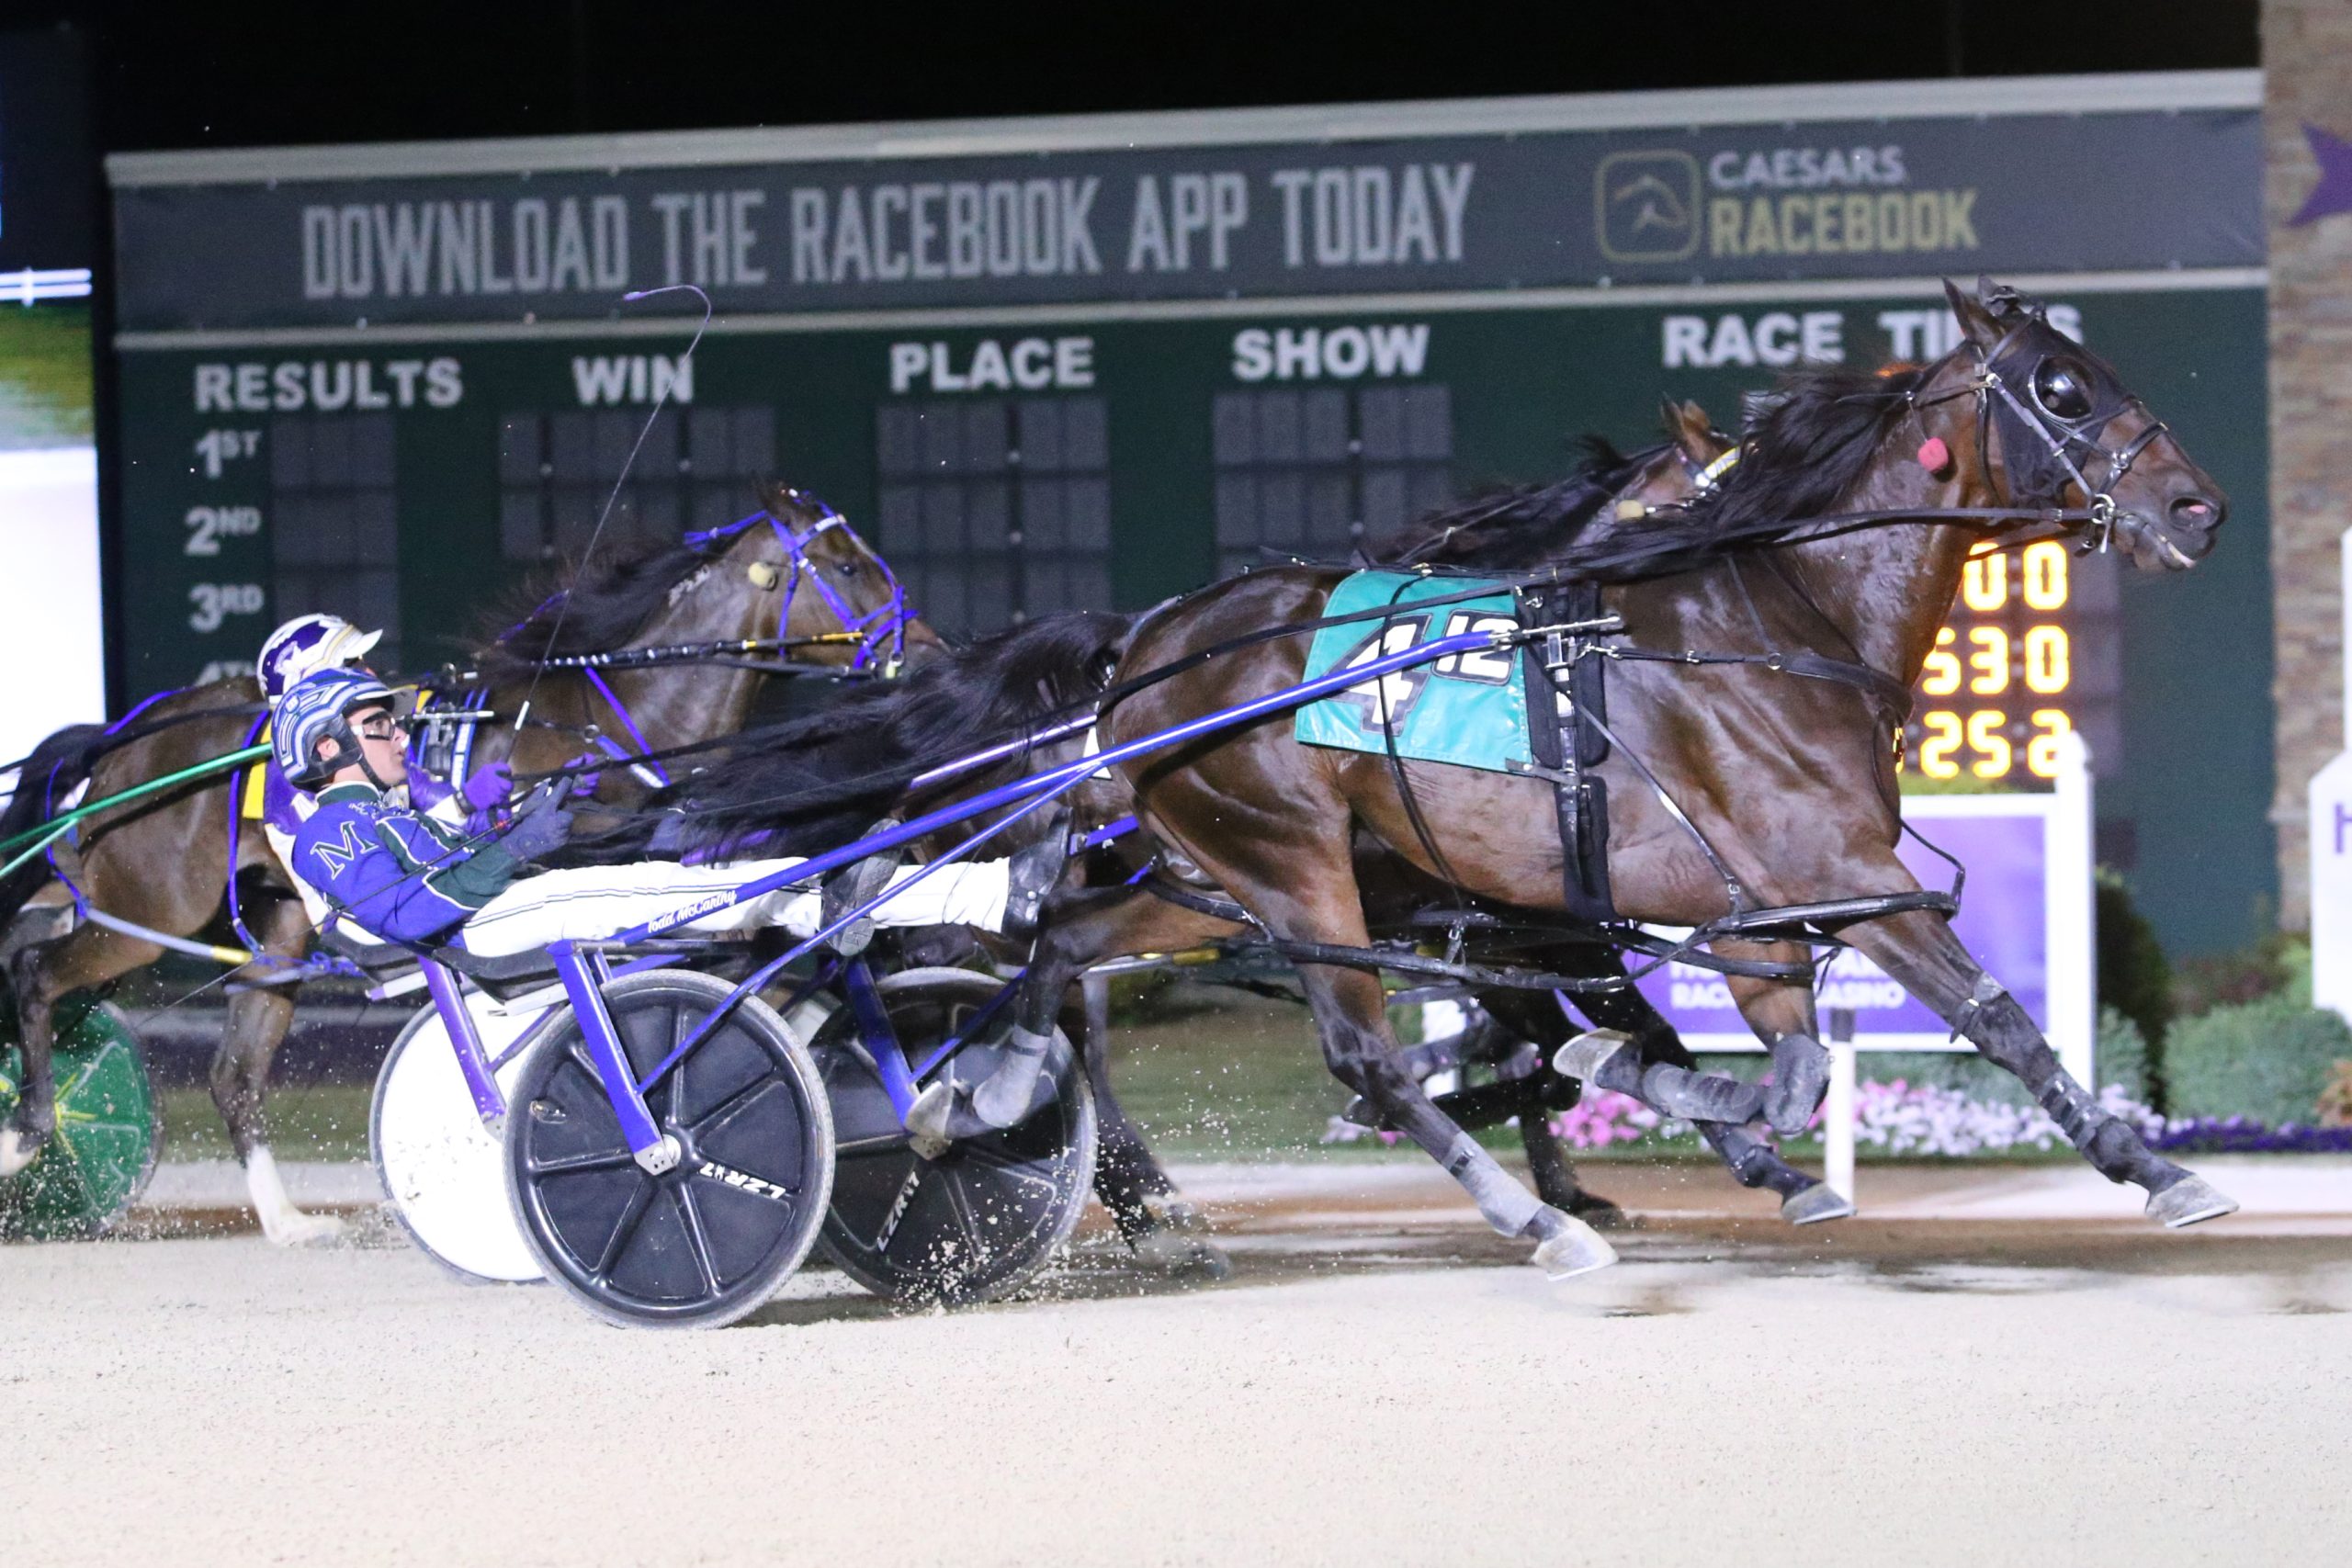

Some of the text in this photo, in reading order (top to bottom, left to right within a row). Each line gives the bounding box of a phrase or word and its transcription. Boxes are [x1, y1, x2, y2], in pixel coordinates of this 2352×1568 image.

[1710, 147, 1903, 187] CAESARS
[303, 164, 1474, 299] DOWNLOAD THE RACEBOOK APP TODAY
[1711, 191, 1978, 255] RACEBOOK
[889, 324, 1430, 393] PLACE SHOW
[1663, 306, 2083, 367] RACE TIS
[194, 355, 695, 411] RESULTS WIN
[185, 507, 261, 556] 2ND
[189, 583, 265, 634] 3RD
[1345, 623, 1419, 725] 4
[310, 820, 379, 881] M
